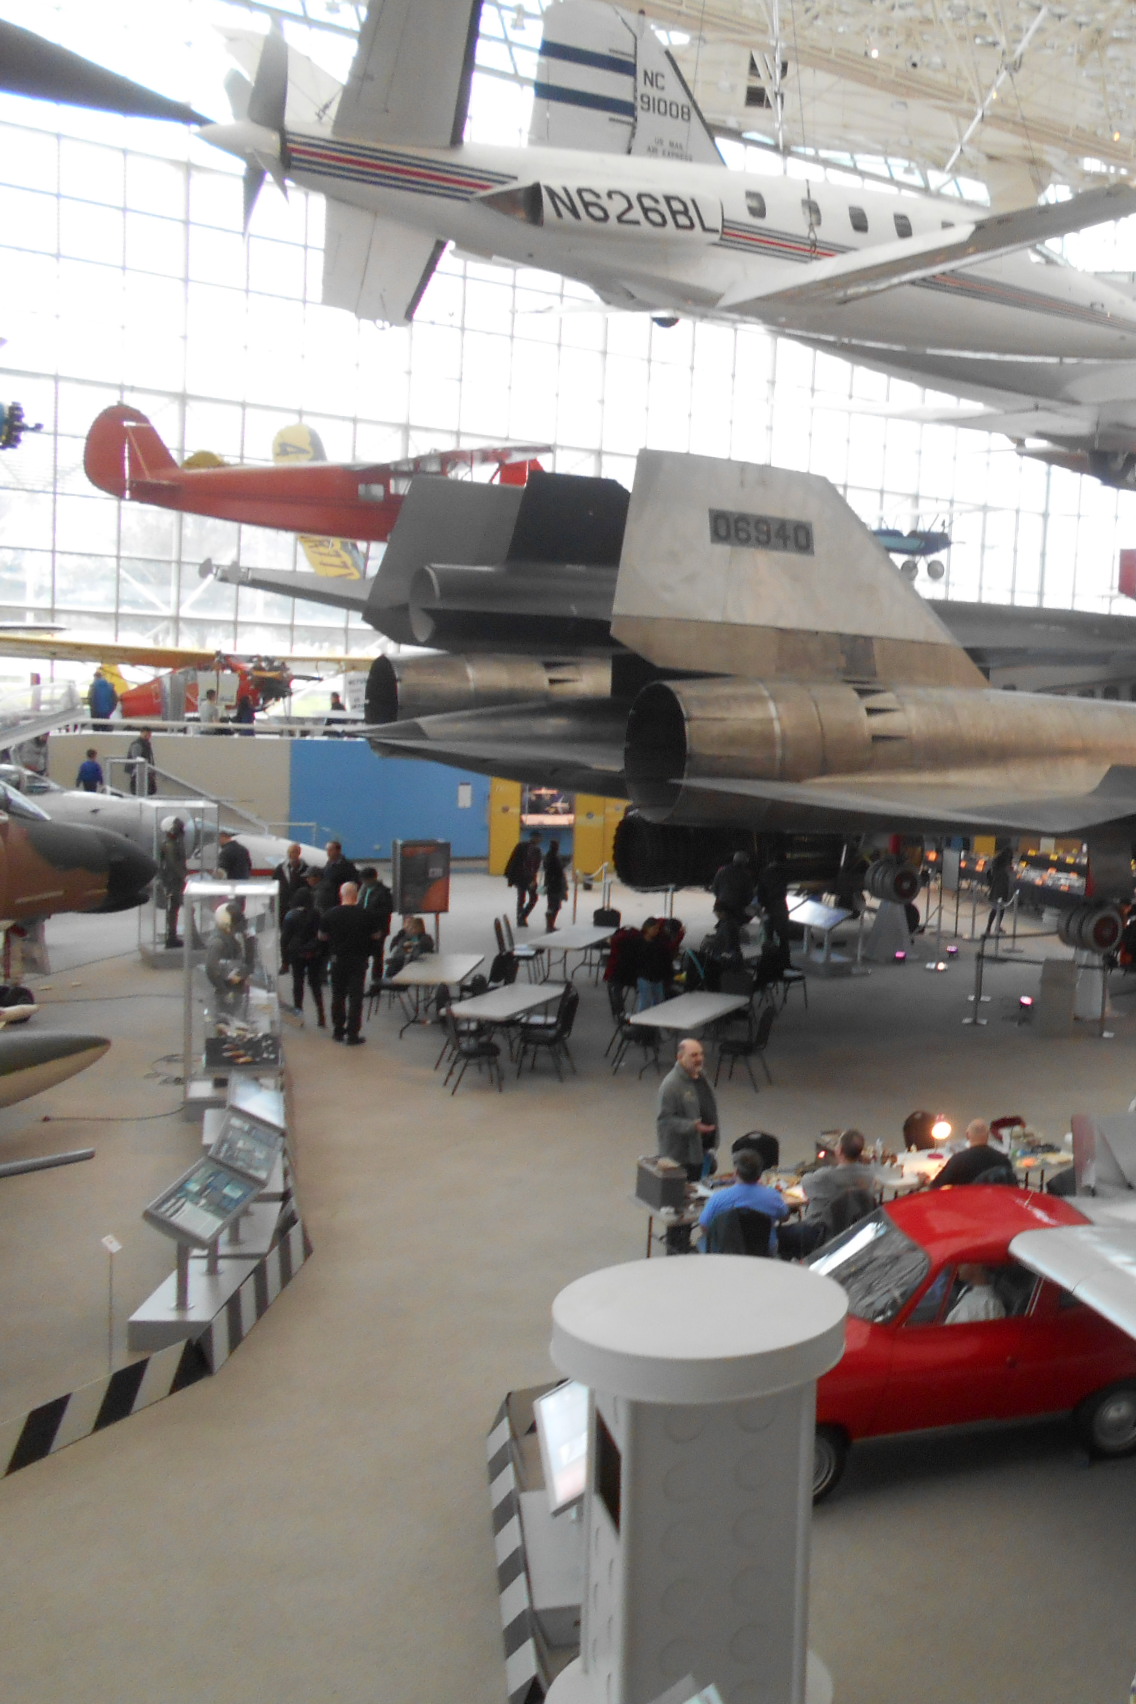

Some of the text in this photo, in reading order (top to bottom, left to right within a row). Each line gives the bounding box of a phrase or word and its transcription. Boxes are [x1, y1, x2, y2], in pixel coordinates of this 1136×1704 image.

[643, 69, 665, 91] NC
[640, 93, 691, 122] 91008
[543, 184, 720, 234] N626BL
[712, 511, 811, 552] 06940
